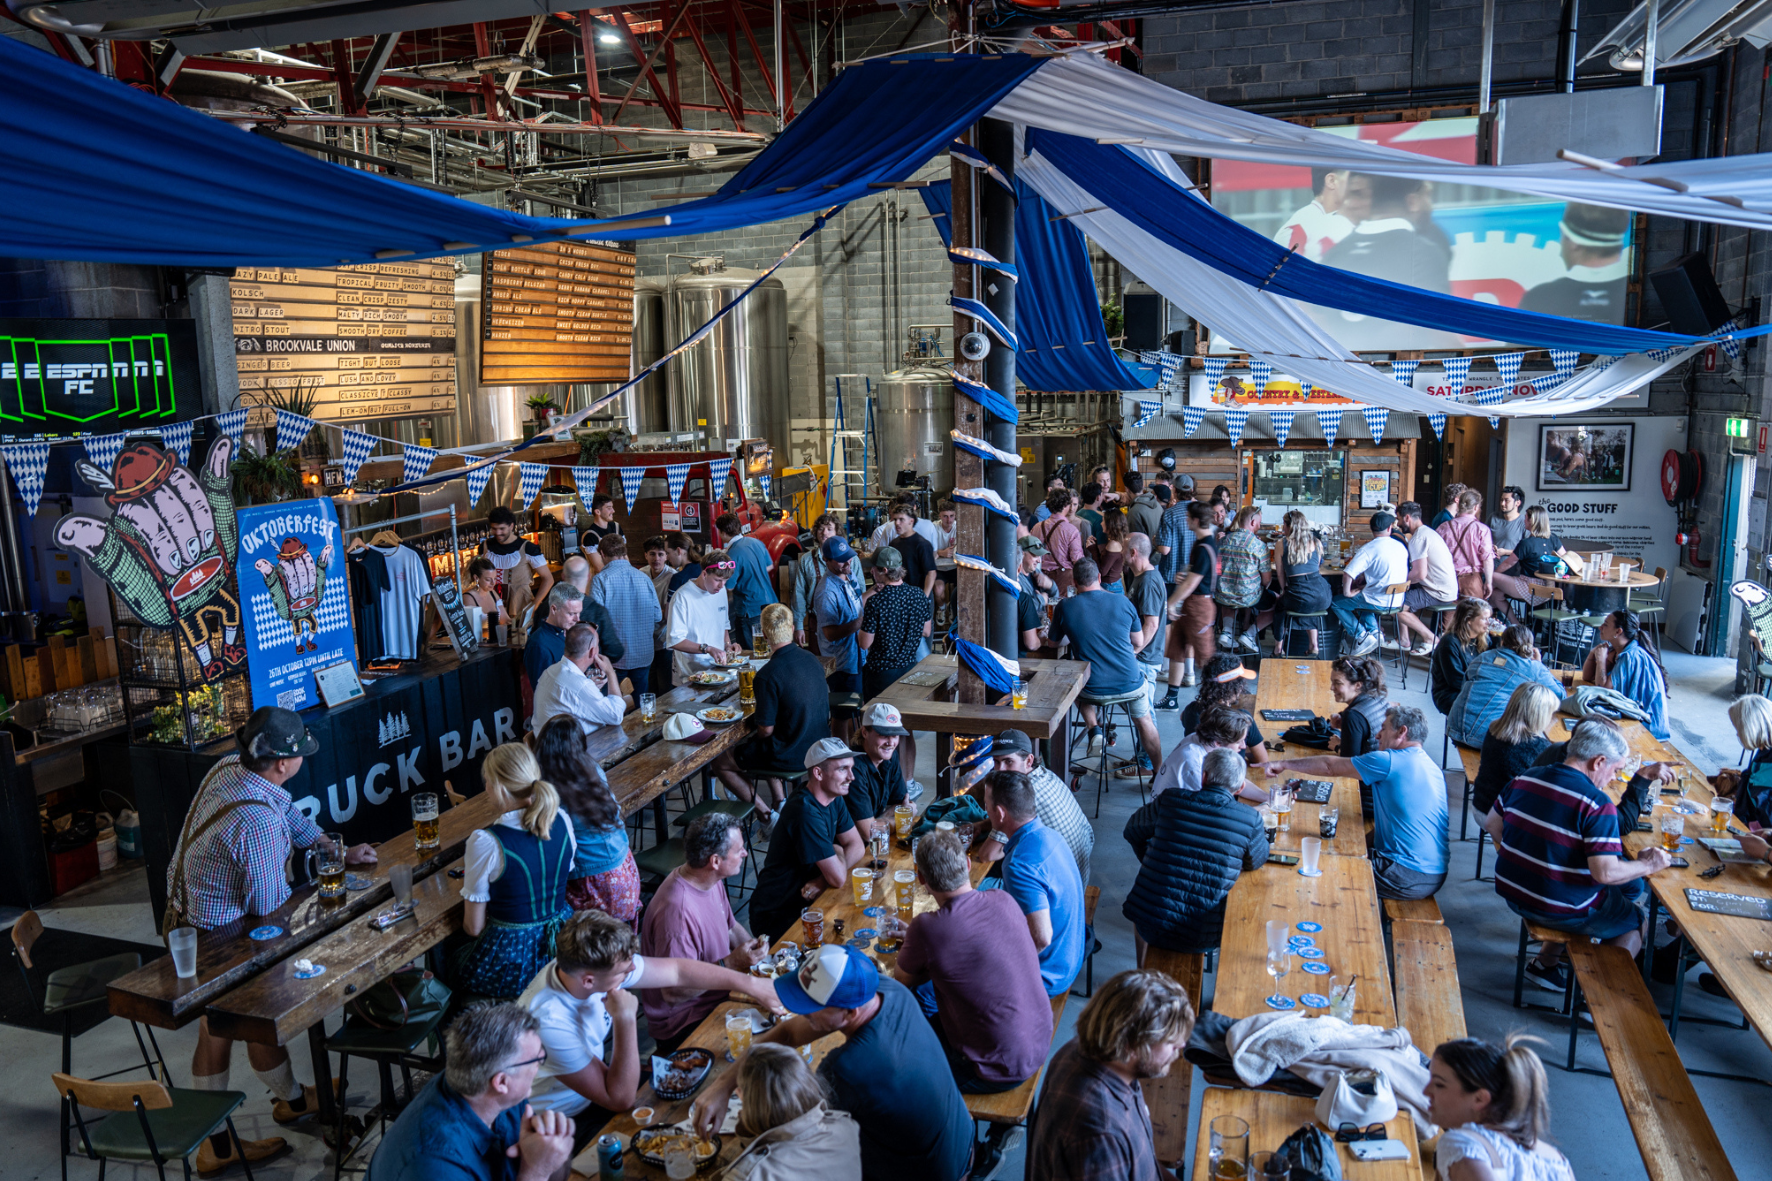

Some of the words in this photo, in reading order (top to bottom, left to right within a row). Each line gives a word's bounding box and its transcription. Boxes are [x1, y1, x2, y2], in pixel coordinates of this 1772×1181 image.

[380, 266, 419, 275] REFRESHING
[338, 277, 371, 287] TROPICAL
[232, 289, 264, 297] KOLSCH
[266, 340, 323, 352] BROOKVALE
[327, 340, 355, 352] UNION
[47, 363, 108, 379] ESPN
[64, 379, 94, 394] FC
[1292, 390, 1300, 399] &
[1538, 497, 1551, 505] the
[1547, 502, 1580, 514] GOOD
[1582, 503, 1618, 514] STUFF
[242, 514, 338, 554] OKTOBERFEST
[269, 666, 282, 679] 26TH
[281, 659, 304, 674] OCTOBER
[304, 656, 317, 667] 12PM
[317, 651, 331, 663] UNTIL
[332, 648, 344, 659] LATE
[293, 686, 306, 697] BOOK
[294, 693, 306, 704] NOW
[439, 706, 516, 773] BAR
